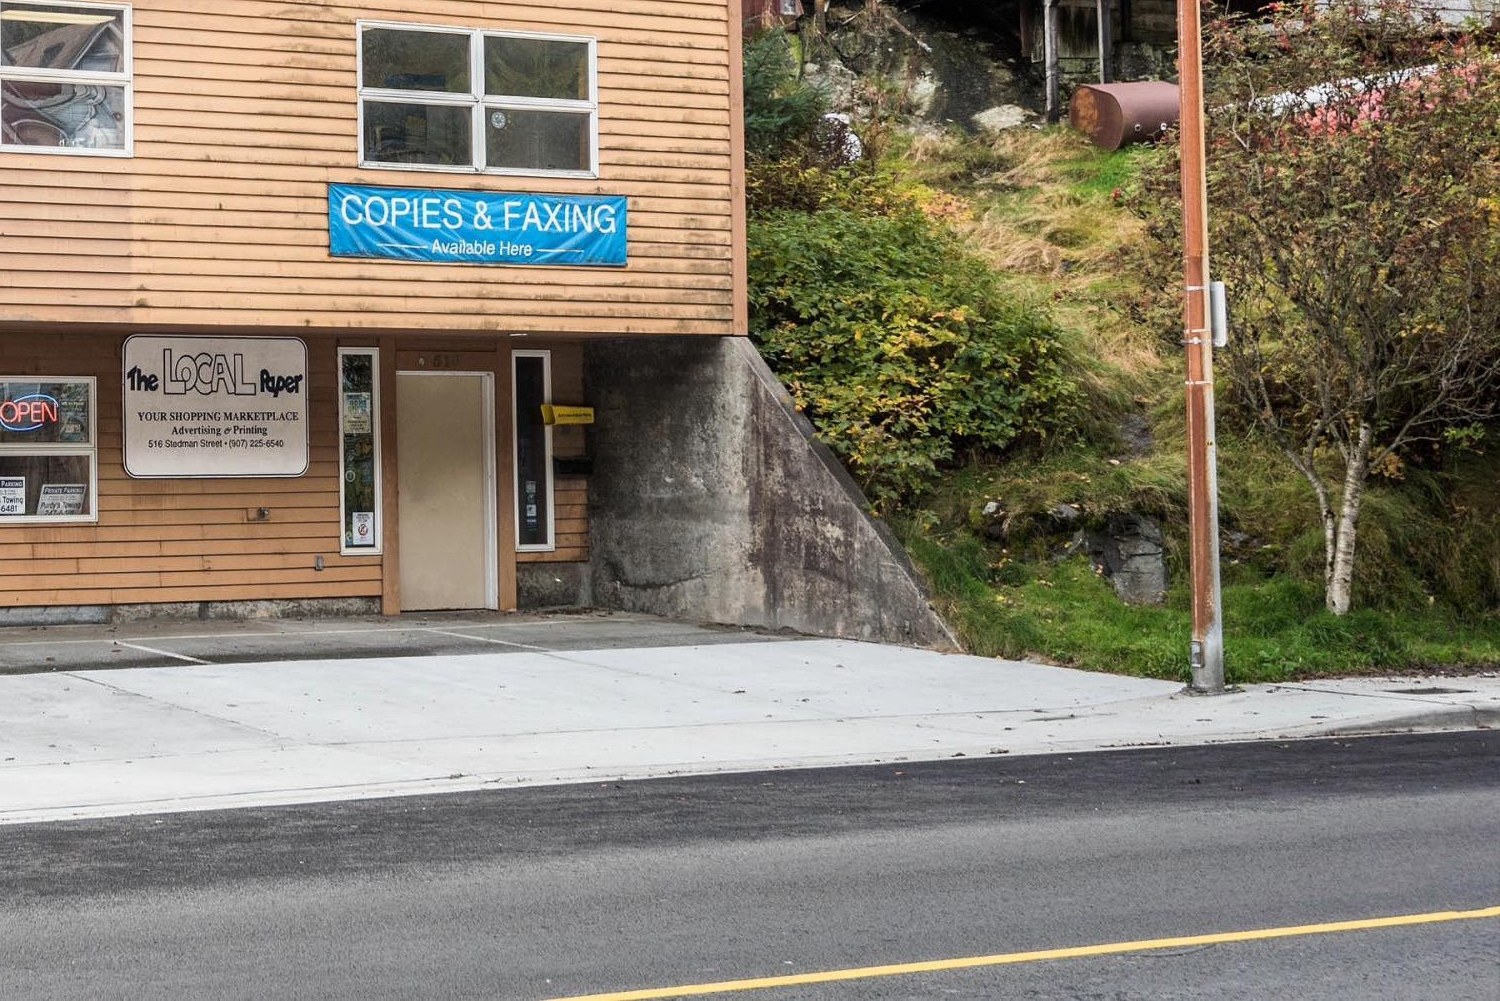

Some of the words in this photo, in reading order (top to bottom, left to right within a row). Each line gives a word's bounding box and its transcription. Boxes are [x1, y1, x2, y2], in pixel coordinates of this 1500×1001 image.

[340, 194, 464, 230] COPIES
[472, 203, 494, 231] &
[503, 200, 617, 234] FAXING
[431, 238, 496, 256] Available
[499, 242, 533, 257] Here
[127, 365, 159, 392] The
[163, 348, 257, 396] LOCAL
[260, 368, 303, 398] Paper
[0, 401, 58, 423] OPEN
[137, 411, 168, 422] YOUR
[169, 411, 221, 423] SHOPPING
[223, 411, 299, 422] MARKETPLACE
[171, 425, 222, 436] Advertising
[233, 426, 268, 436] Printing
[164, 439, 198, 449] Stedman
[200, 439, 223, 448] Street
[228, 439, 248, 450] (907)
[3, 496, 24, 505] Towing
